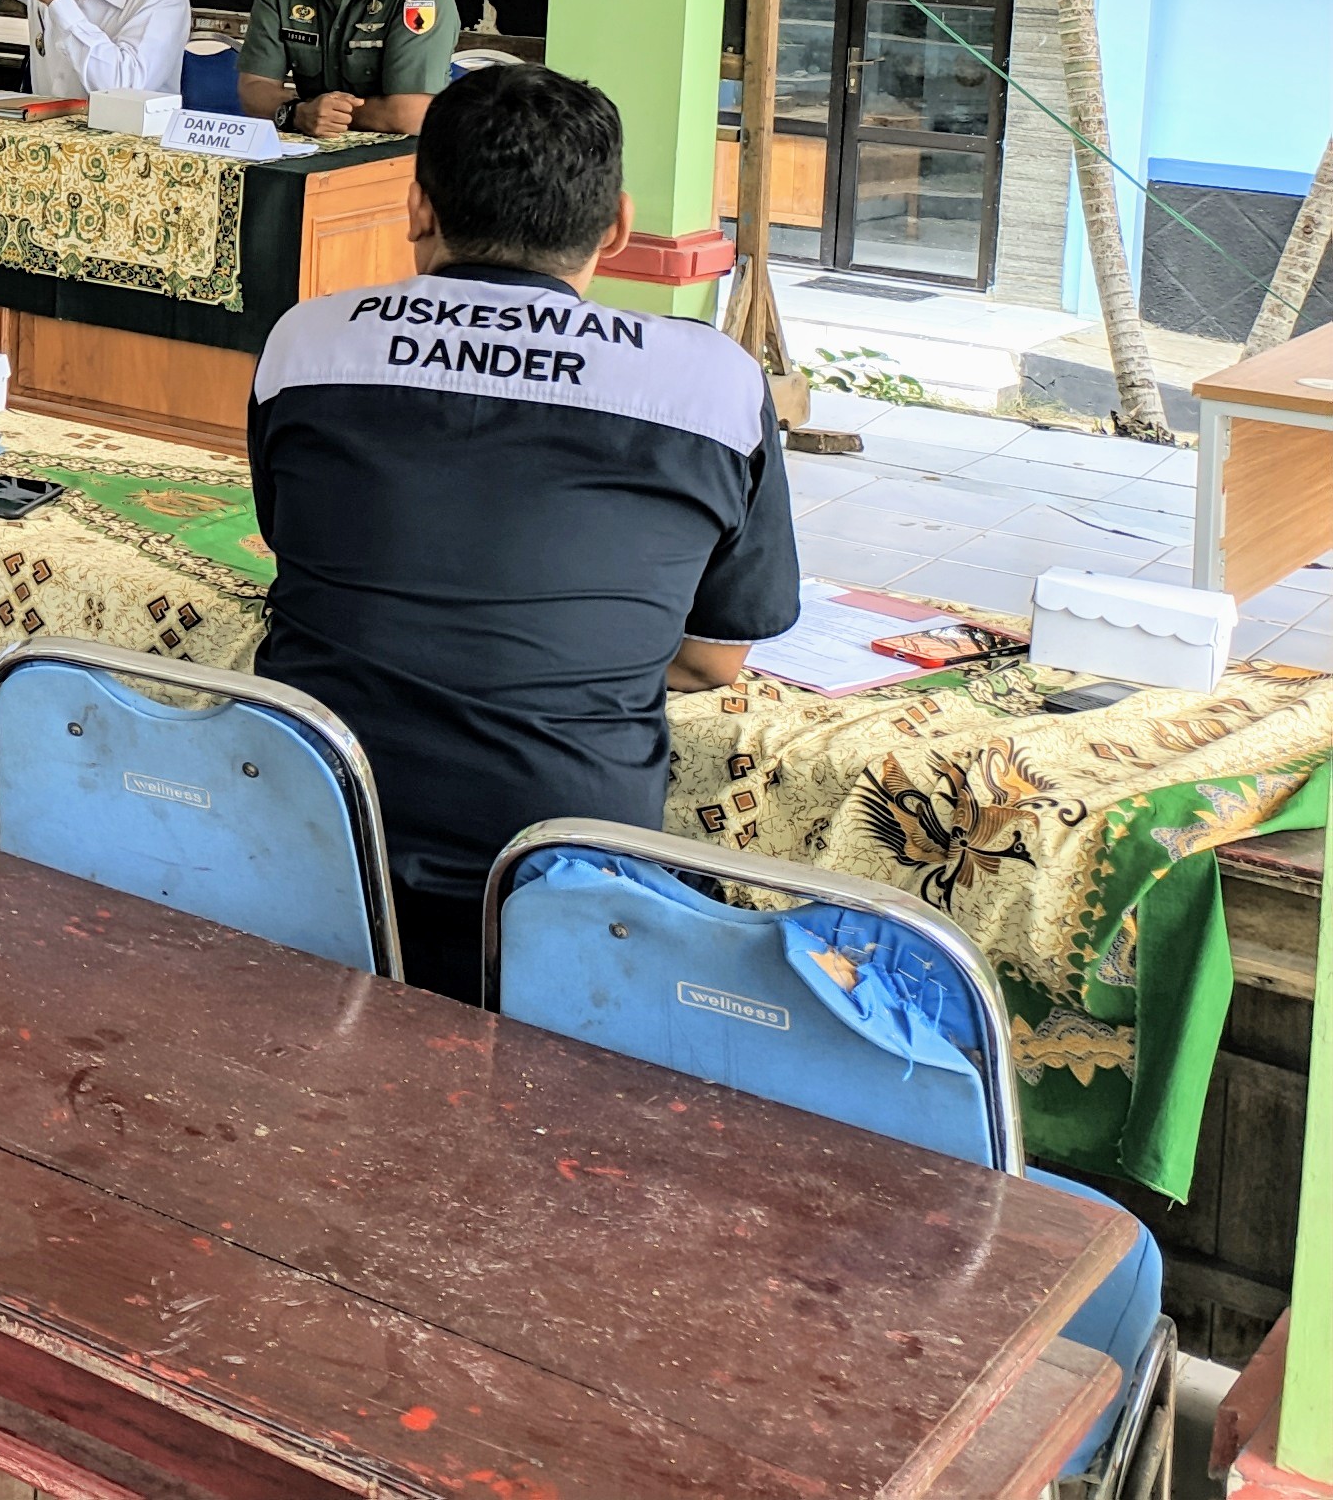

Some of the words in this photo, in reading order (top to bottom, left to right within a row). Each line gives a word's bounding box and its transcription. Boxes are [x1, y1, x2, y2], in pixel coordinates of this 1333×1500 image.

[184, 117, 216, 132] DAN
[217, 121, 247, 136] POS
[187, 132, 231, 149] RAMIL
[349, 295, 644, 350] PUSKESWAN
[387, 334, 586, 385] DANDER
[133, 779, 203, 804] wellness
[687, 990, 780, 1023] wellness
